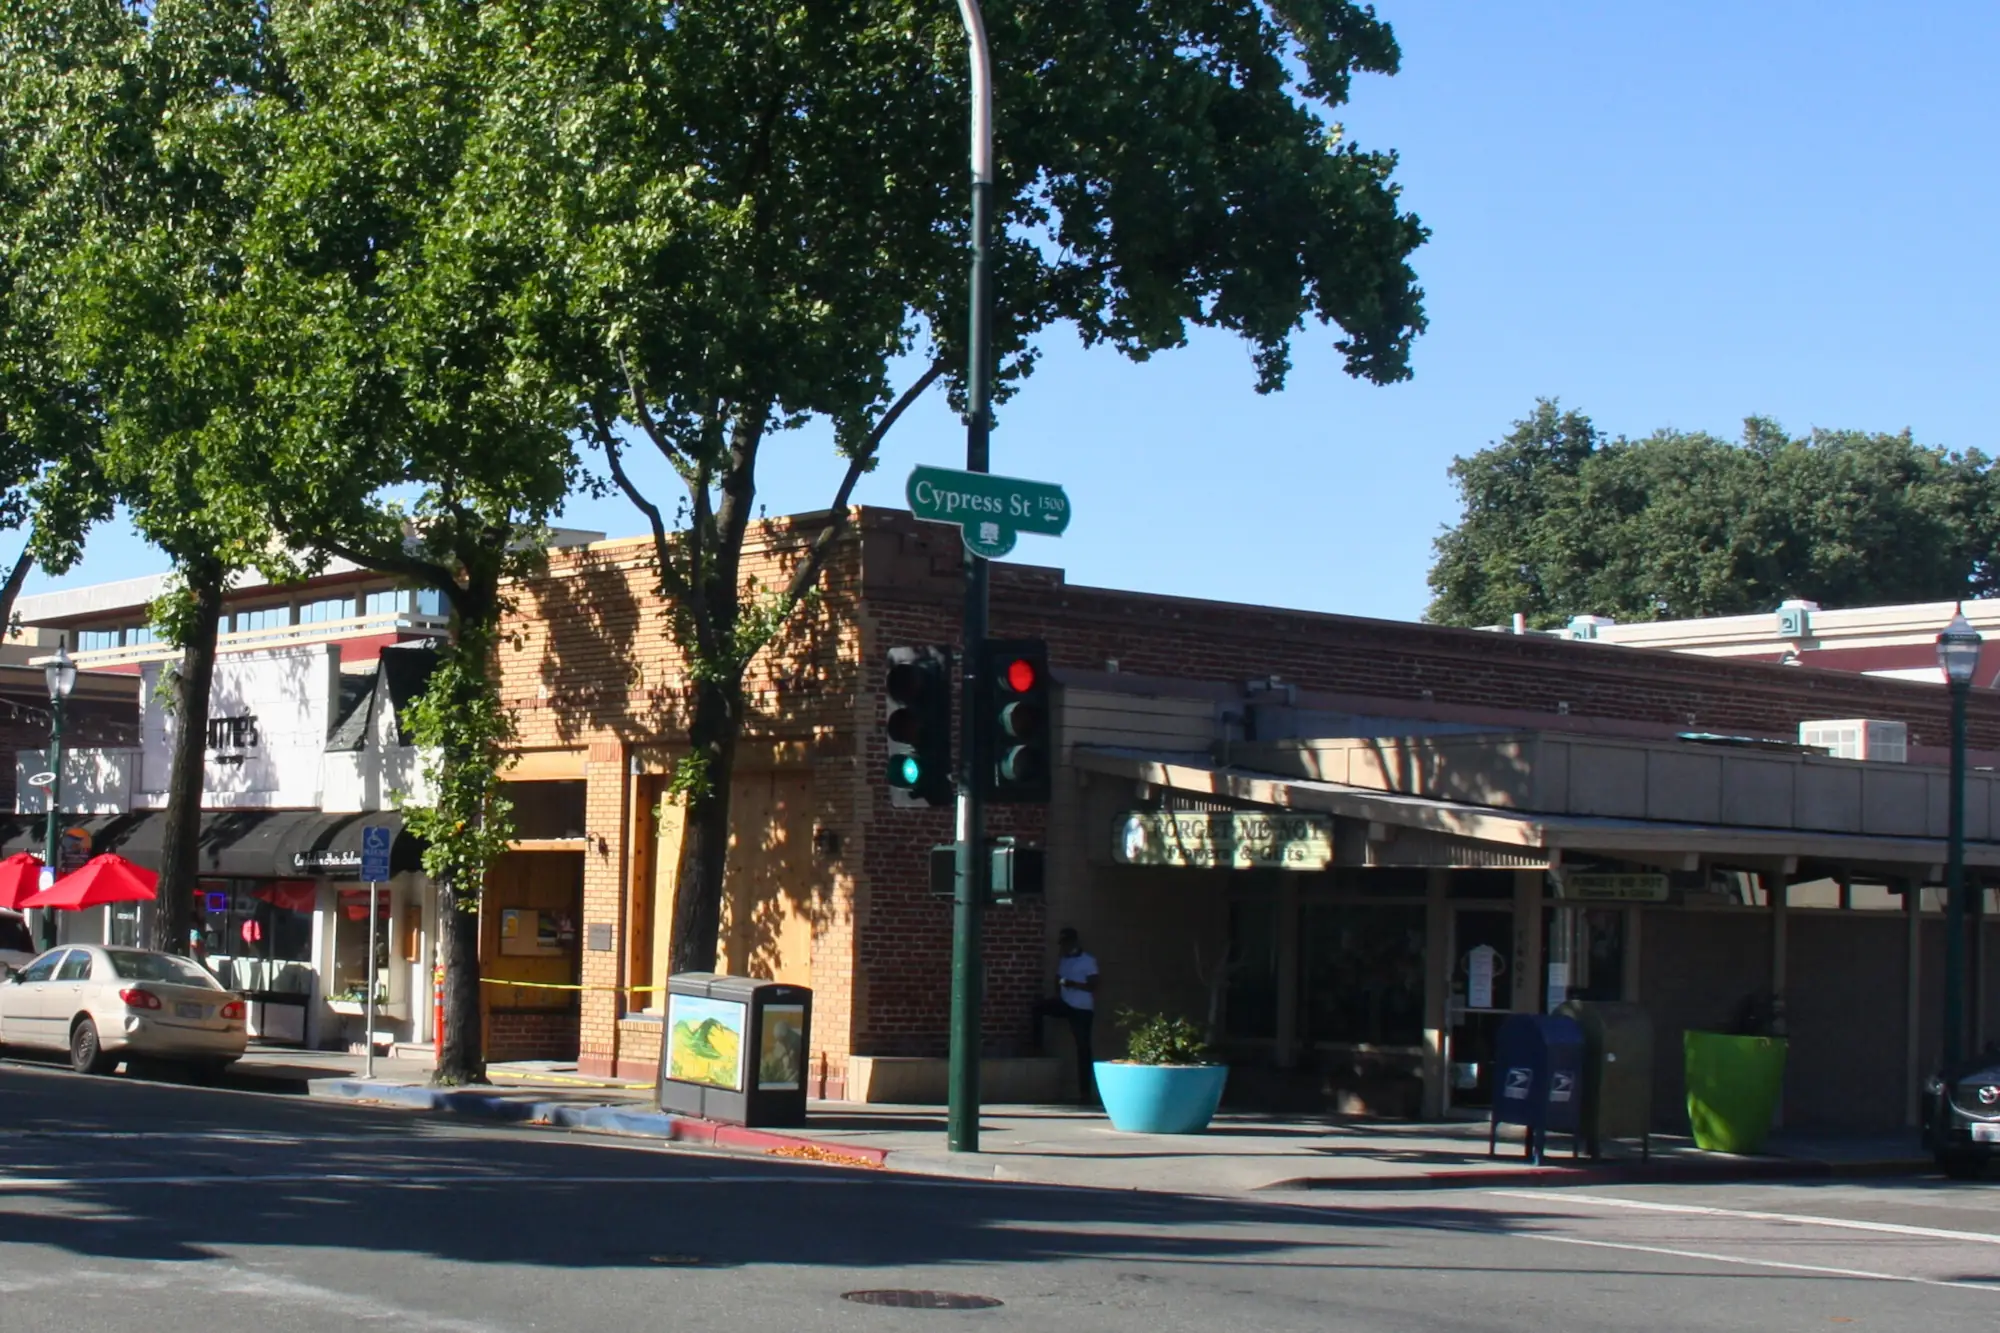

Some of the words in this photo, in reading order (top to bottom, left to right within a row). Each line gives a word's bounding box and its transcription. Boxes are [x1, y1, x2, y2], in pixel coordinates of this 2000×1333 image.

[915, 481, 1002, 513] Cypress
[1009, 493, 1032, 517] St
[1038, 496, 1065, 511] 1500
[1154, 819, 1229, 839] FORGET
[1241, 820, 1271, 841] ME
[1279, 820, 1322, 841] NOT
[1239, 847, 1253, 860] &
[1260, 845, 1304, 861] Gifts
